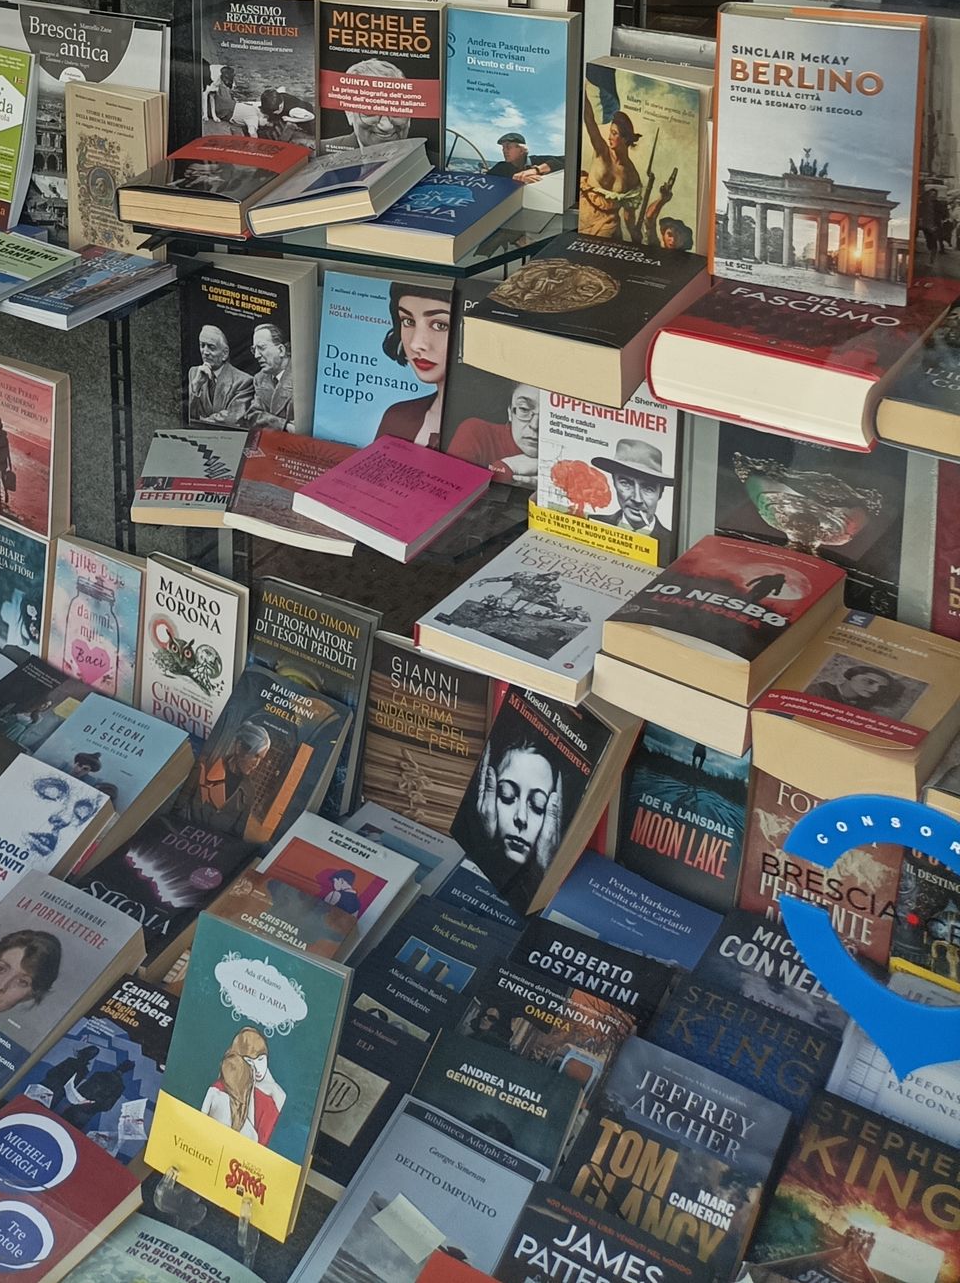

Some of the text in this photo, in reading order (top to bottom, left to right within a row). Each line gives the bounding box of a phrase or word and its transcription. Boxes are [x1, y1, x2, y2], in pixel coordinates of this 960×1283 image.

[226, 13, 286, 27] RECALCATI
[230, 3, 282, 17] MASSIMO
[332, 11, 426, 33] MICHELE
[29, 16, 87, 42] Brescia
[328, 29, 431, 53] FERRERO
[467, 36, 550, 56] Andrea Pasqualetto
[59, 42, 109, 63] antica
[467, 46, 526, 62] Lucio Trevisan
[731, 45, 795, 60] SINCLAIR
[339, 77, 412, 90] QUINTA EDIZIONE
[730, 58, 884, 96] BERLINO
[730, 85, 761, 94] STORIA
[764, 88, 792, 98] DELLA
[730, 95, 747, 104] CHE
[750, 97, 761, 105] HA
[765, 99, 806, 110] SEGNATO
[826, 106, 863, 117] SECOLO
[730, 287, 901, 327] FASCISMO
[325, 344, 377, 367] Donne
[323, 365, 419, 393] che pensano
[323, 383, 374, 403] troppo
[159, 576, 220, 615] MAURO
[646, 581, 682, 597] JO
[155, 592, 221, 634] CORONA
[391, 657, 459, 694] GIANNI
[391, 673, 459, 709] SIMONI
[525, 688, 588, 751] Rosella Postorino
[631, 806, 731, 881] MOON LAKE
[760, 853, 898, 918] BRESCIA
[528, 950, 639, 1006] COSTANTINI
[548, 940, 634, 984] ROBERTO
[112, 988, 172, 1027] Läckberg
[121, 980, 169, 1010] Camilla
[232, 979, 287, 1012] COME D'ARIA
[446, 1068, 548, 1119] GENITORI CERCASI
[459, 1063, 542, 1103] ANDREA VITALI
[637, 1069, 758, 1140] JEFFREY
[632, 1095, 740, 1164] ARCHER
[4, 1131, 52, 1171] MICHELA
[173, 1135, 214, 1166] Vincitore
[591, 1118, 679, 1196] TOM
[799, 1124, 960, 1232] KING
[669, 1189, 731, 1231] CAMERON
[697, 1189, 737, 1217] MARC
[7, 1220, 27, 1240] Tre
[553, 1224, 664, 1283] JAMES
